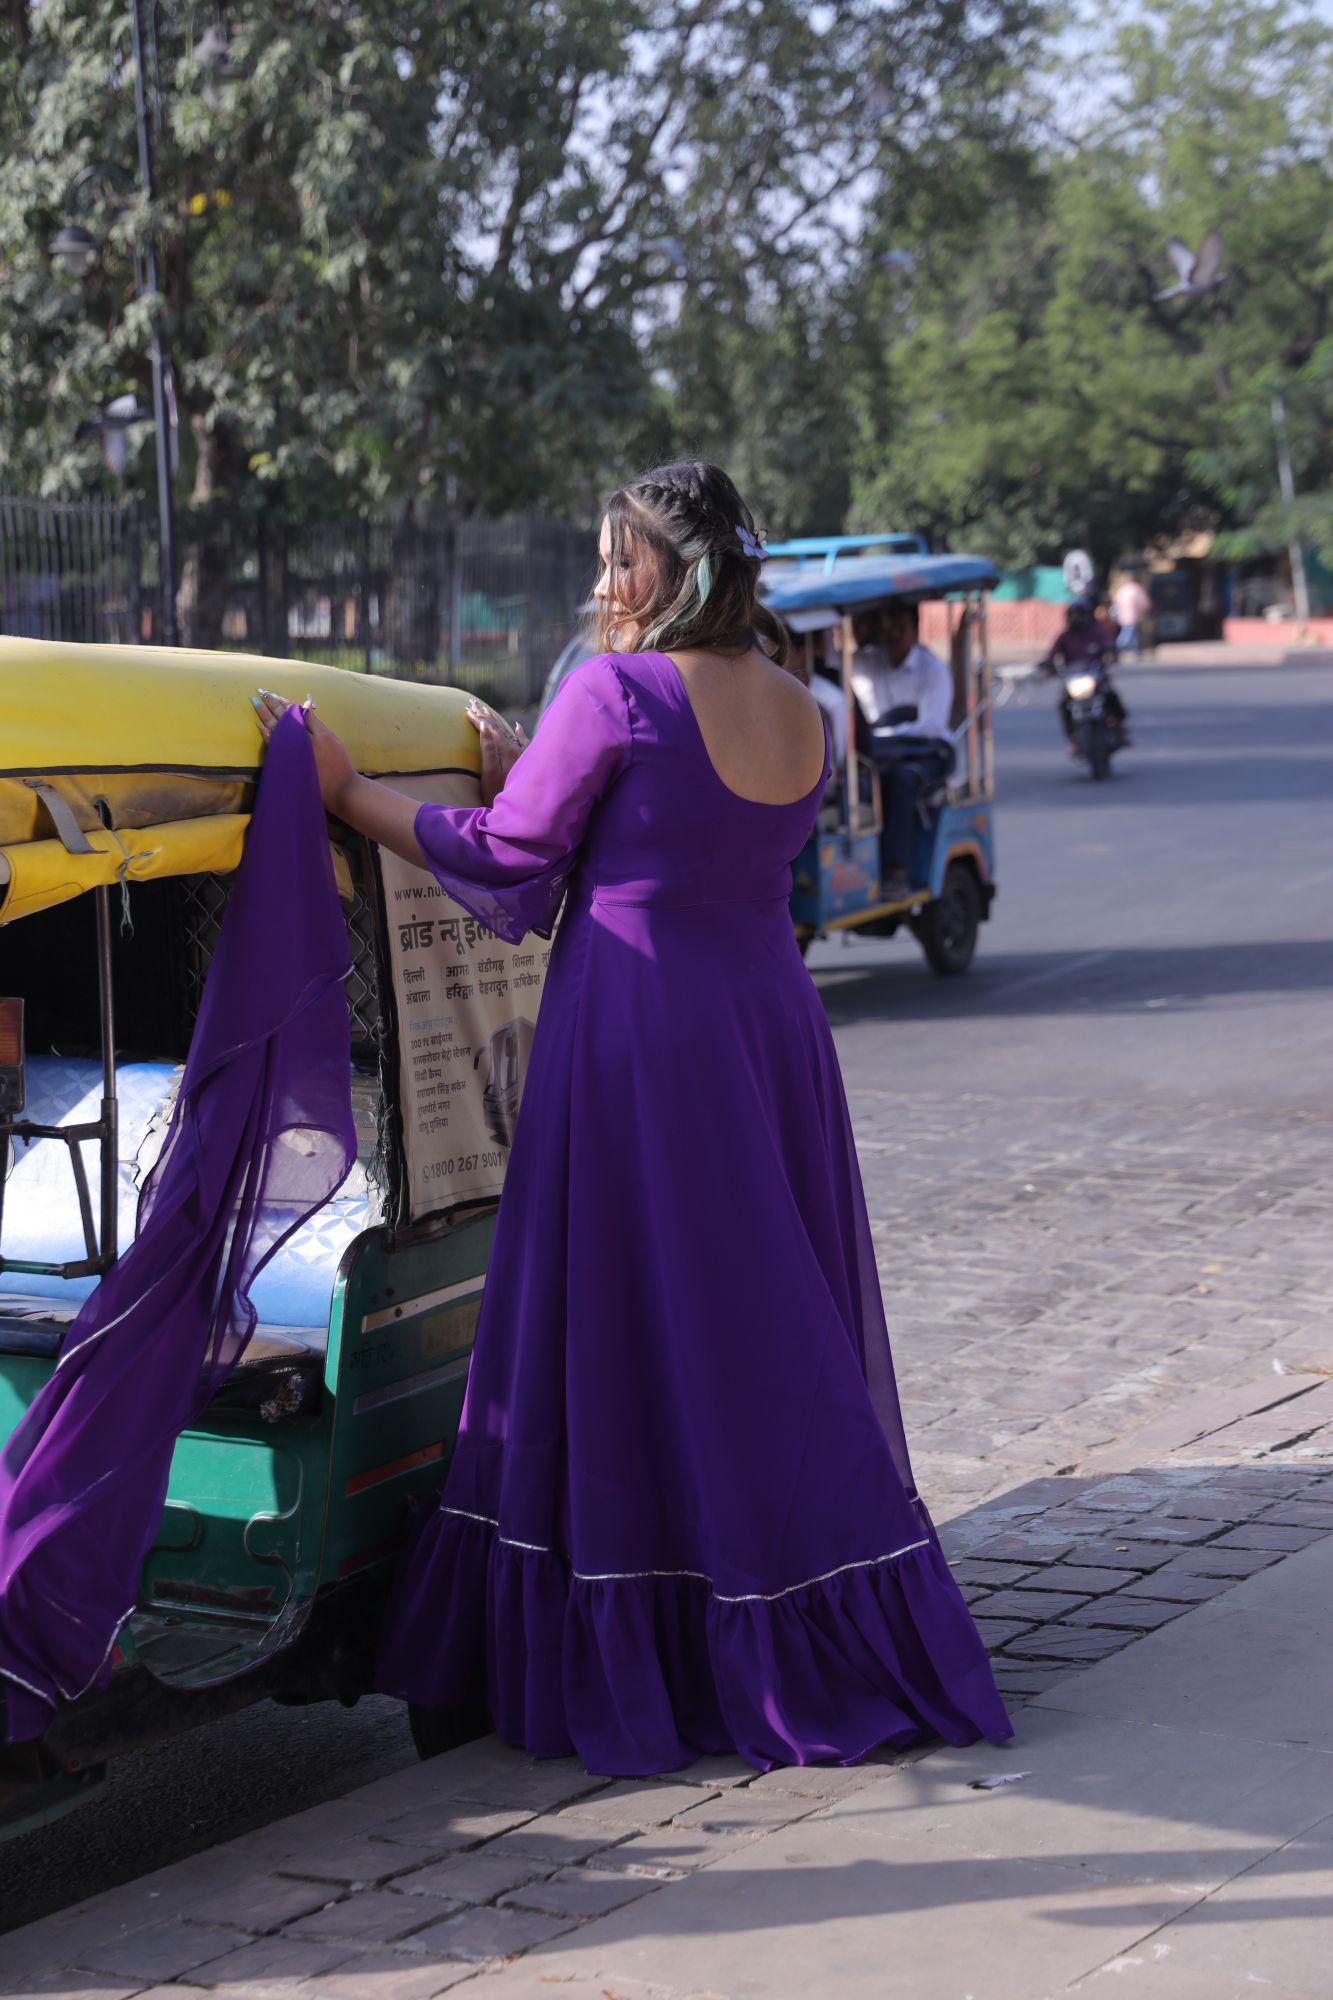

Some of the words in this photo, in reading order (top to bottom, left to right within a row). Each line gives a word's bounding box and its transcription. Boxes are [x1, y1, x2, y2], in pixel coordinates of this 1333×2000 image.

[398, 914, 434, 952] ब्रांड
[438, 918, 466, 955] न्यू
[402, 966, 425, 985] दिल्ली
[445, 965, 470, 978] आगरा
[477, 957, 505, 974] चंडीगढ़
[512, 954, 534, 969] शिमला
[406, 990, 431, 1005] अंबाला
[445, 983, 474, 999] हरिद्वार
[479, 979, 508, 997] देहरादून
[423, 1037, 430, 1047] ft
[453, 1045, 471, 1057] स्टेशन
[430, 1159, 454, 1179] 1800
[458, 1154, 479, 1172] 267
[482, 1152, 502, 1169] 9001
